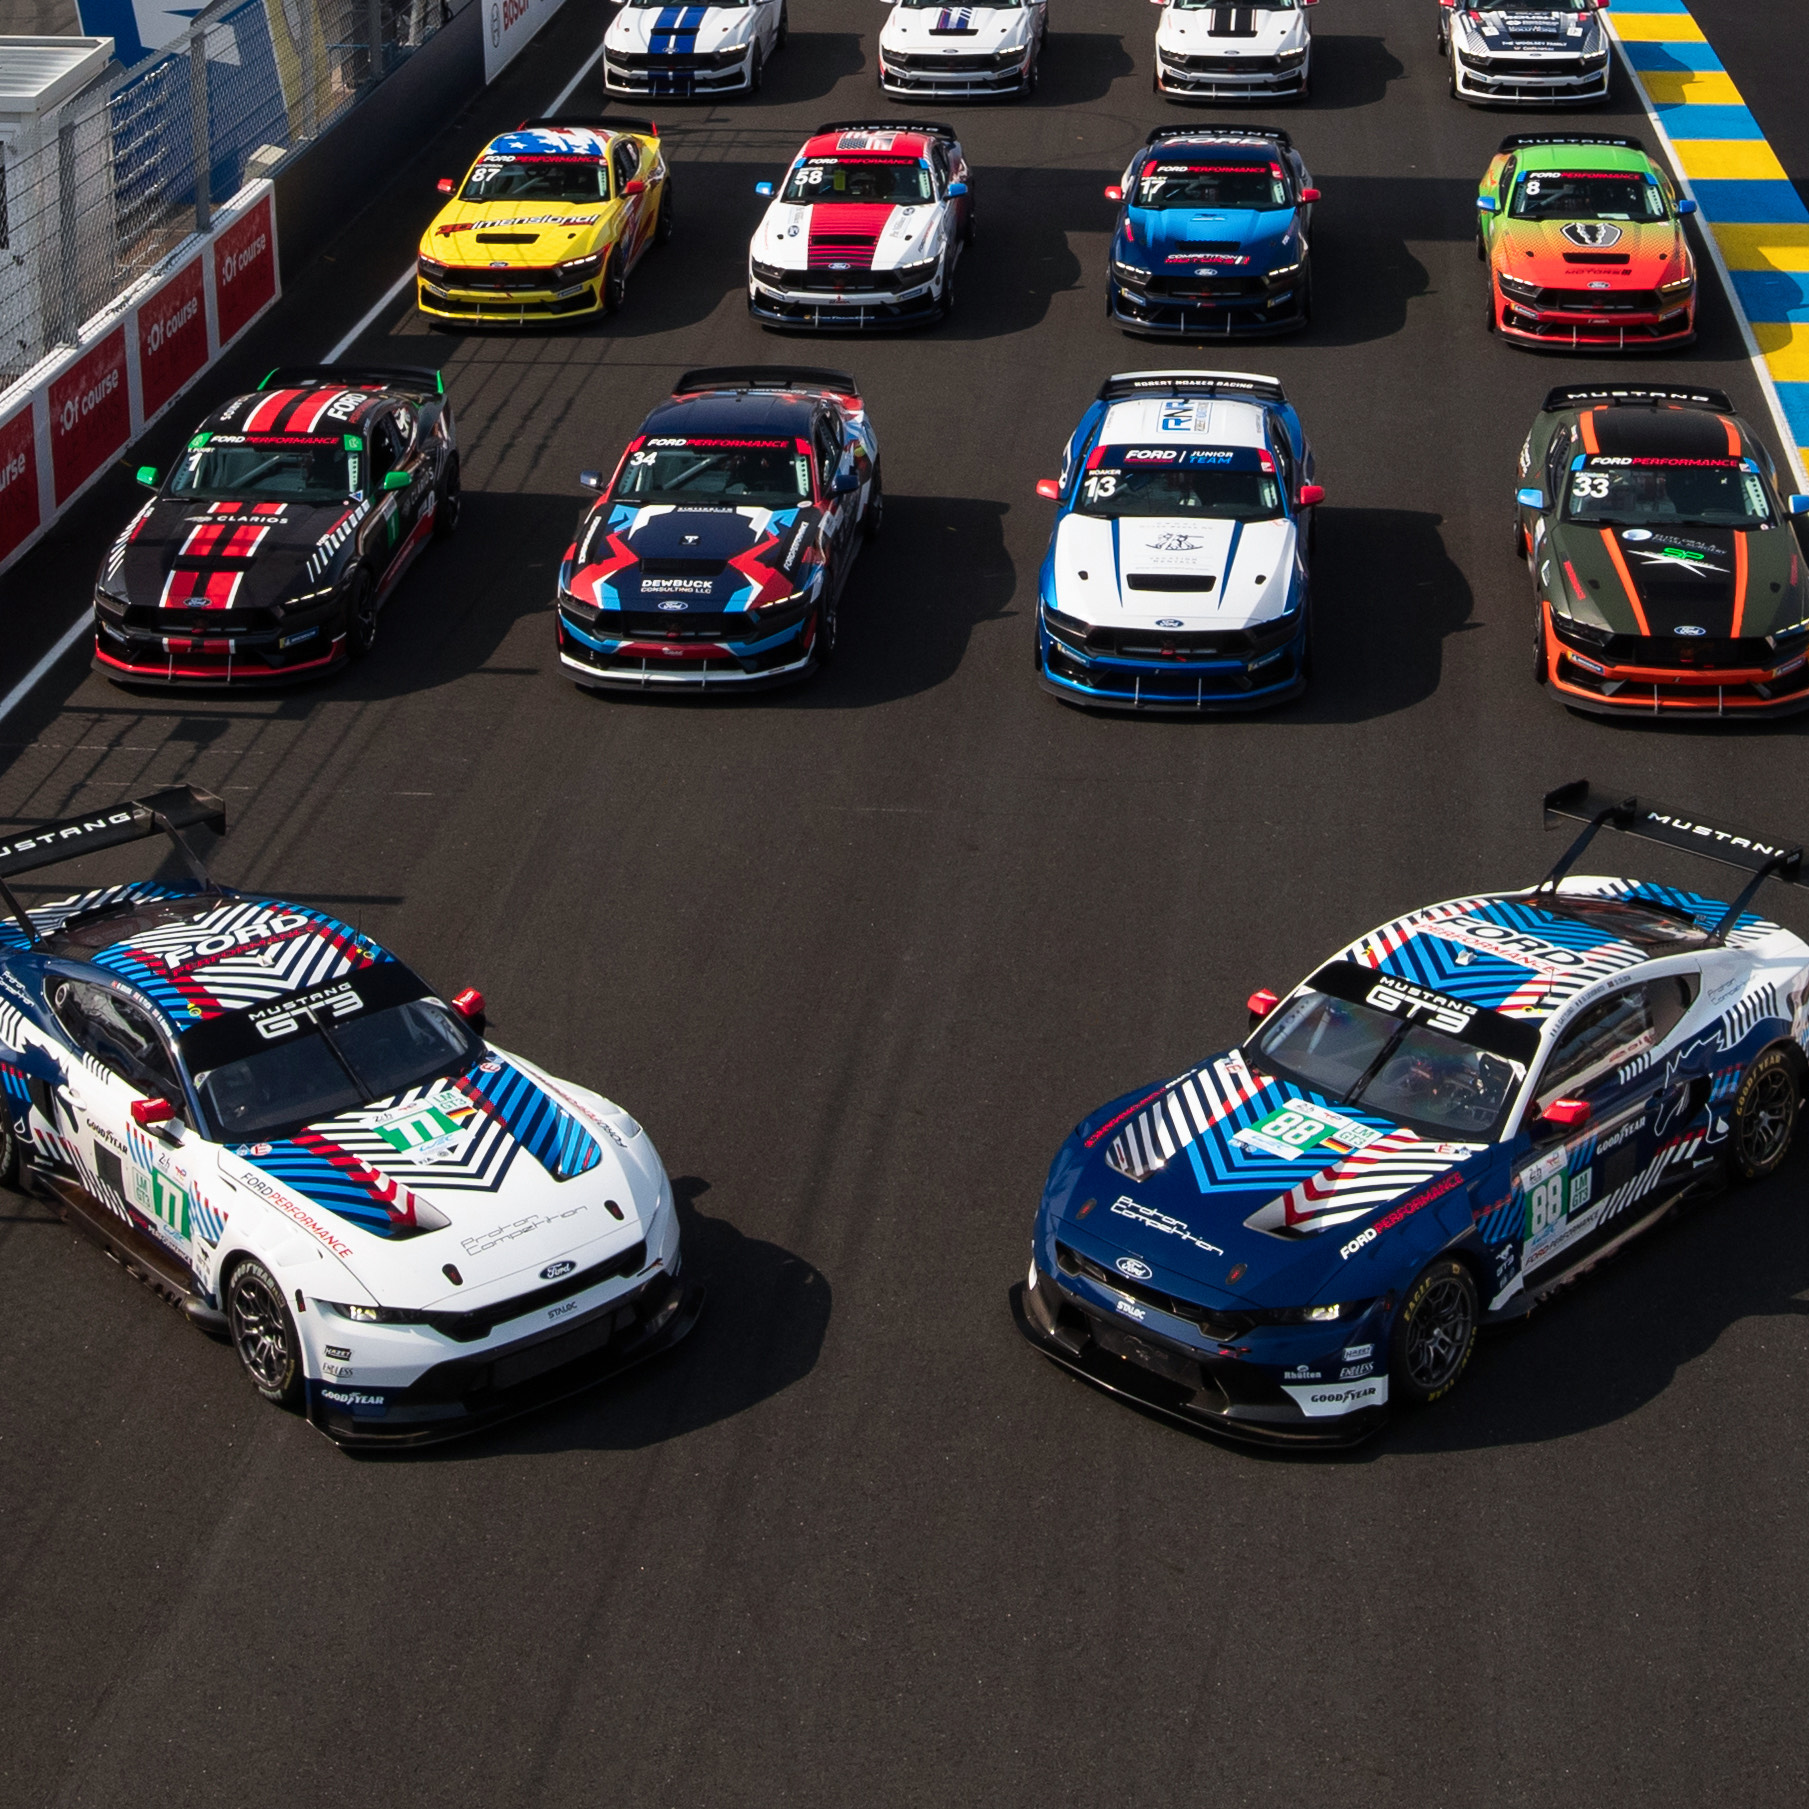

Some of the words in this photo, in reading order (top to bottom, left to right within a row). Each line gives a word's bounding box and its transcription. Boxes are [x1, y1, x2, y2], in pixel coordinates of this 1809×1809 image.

[1164, 137, 1268, 145] FORD
[482, 154, 516, 163] FORD
[808, 157, 838, 165] FORD
[471, 168, 502, 183] 87
[794, 170, 824, 185] 58
[1188, 166, 1267, 174] PERFORMANCE
[1560, 172, 1641, 180] PERFORMANCE
[1140, 179, 1167, 195] 17
[1526, 180, 1541, 196] 8
[237, 233, 266, 267] course
[165, 296, 199, 334] course
[82, 368, 120, 413] course
[1217, 381, 1253, 389] RACING
[1567, 391, 1709, 401] MUSTANG
[327, 393, 367, 420] FORD
[210, 435, 245, 443] FORD
[647, 439, 686, 447] FORD
[686, 439, 788, 448] PERFORMANCE
[630, 452, 658, 466] 34
[1125, 450, 1177, 459] FORD
[1189, 456, 1233, 464] TEAM
[1591, 457, 1632, 465] FORD
[1632, 458, 1738, 467] PERFORMANCE
[1084, 476, 1116, 498] 13
[1572, 477, 1609, 498] 33
[217, 515, 289, 524] CLARIOS
[642, 580, 713, 588] DEWBUCK
[164, 914, 310, 969] FORD
[171, 920, 319, 976] PERFORMANCE
[1416, 923, 1560, 975] PERFORMANCE
[1431, 915, 1586, 969] FORD
[248, 982, 352, 1021] MUSTANG
[1379, 975, 1478, 1015] MUSTANG
[255, 991, 364, 1040] GT3
[1365, 985, 1478, 1033] GT3
[432, 1091, 455, 1102] LM
[439, 1097, 467, 1110] GT3
[86, 1118, 128, 1155] GOODYEAR
[383, 1114, 445, 1147] 77
[1261, 1111, 1326, 1146] 88
[1596, 1117, 1646, 1155] GOODYEAR
[136, 1171, 148, 1188] LM
[1575, 1174, 1587, 1191] LM
[1532, 1174, 1562, 1235] 88
[1572, 1191, 1588, 1208] GT3
[240, 1172, 273, 1196] FORD
[267, 1190, 354, 1261] PERFORMANCE
[1112, 1195, 1188, 1229] Proton
[1341, 1228, 1378, 1260] FORD
[1374, 1172, 1464, 1235] PERFORMANCE
[460, 1213, 541, 1249] Proton
[466, 1205, 588, 1257] Competition
[1110, 1203, 1224, 1257] Competition
[547, 1301, 578, 1319] STALOC
[1116, 1300, 1146, 1320] STALOC
[1284, 1370, 1322, 1380] Rhütten
[1339, 1362, 1375, 1380] ENDLESS
[321, 1388, 384, 1406] GOODYEAR
[1310, 1386, 1377, 1404] GOODYEAR
